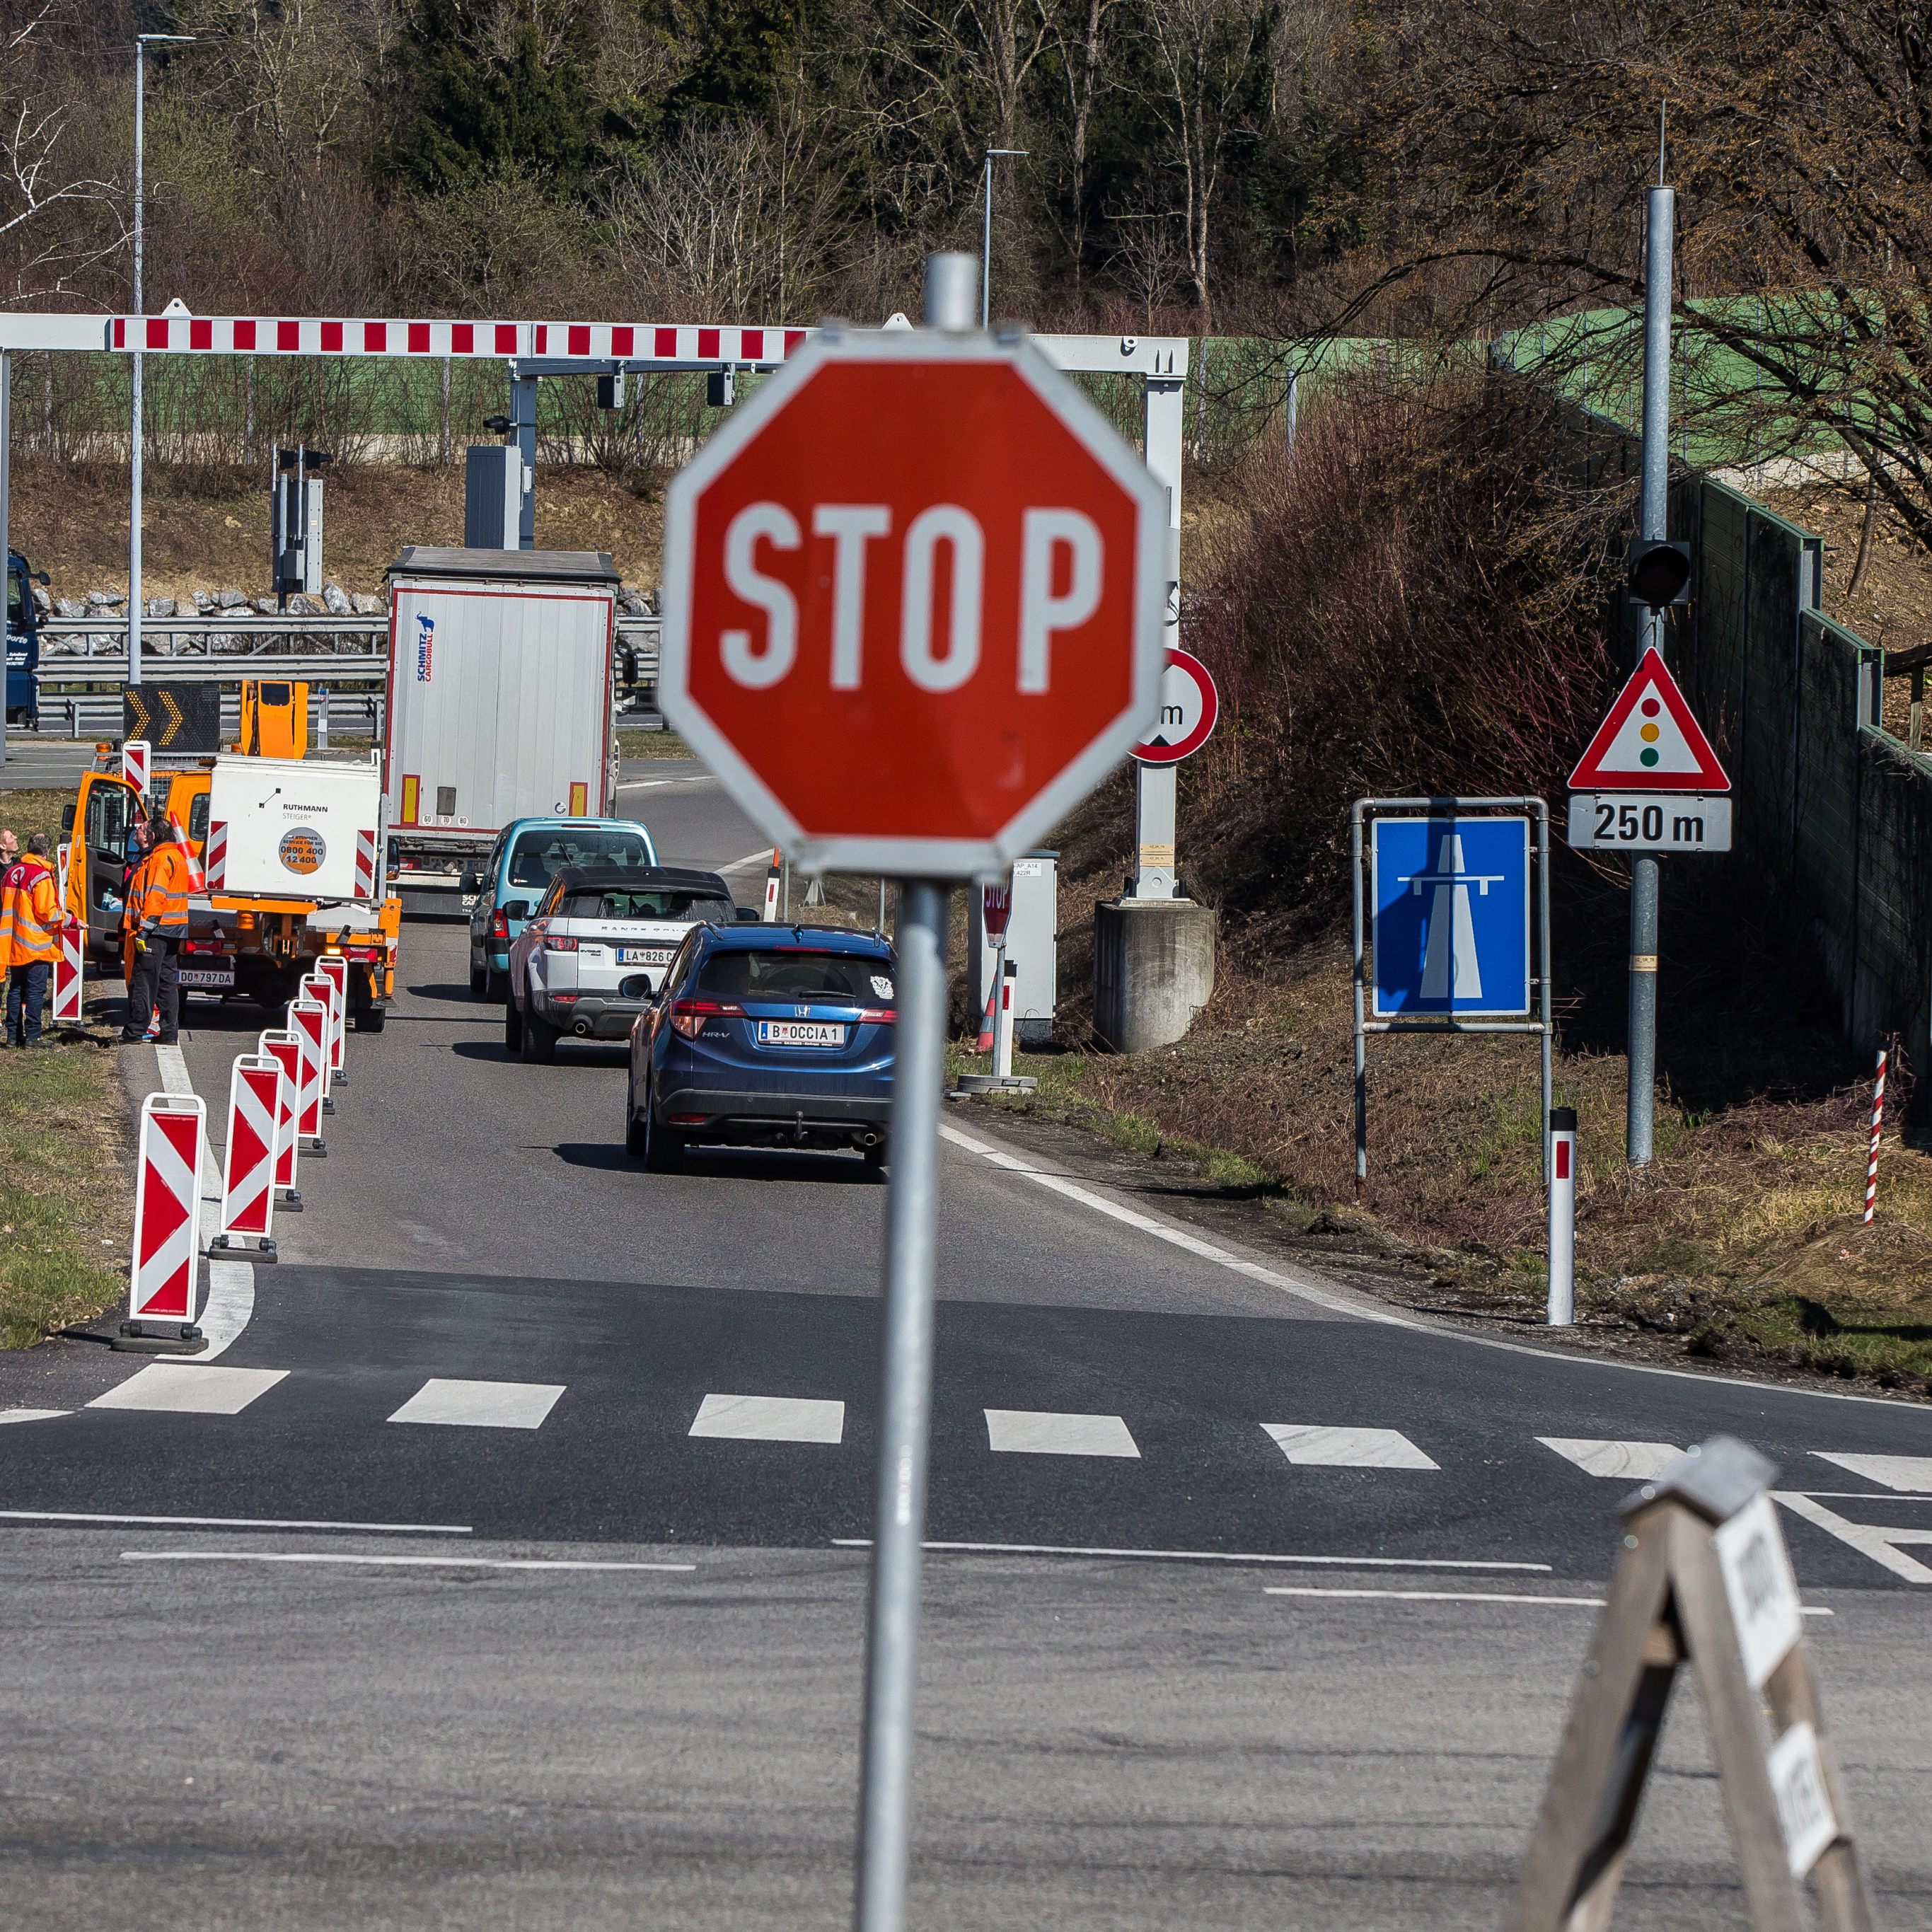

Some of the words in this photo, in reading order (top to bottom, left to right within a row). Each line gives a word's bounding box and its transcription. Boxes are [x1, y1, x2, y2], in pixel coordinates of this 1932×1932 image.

[719, 501, 1104, 695] STOP
[417, 632, 427, 682] SCHMITZ
[1160, 705, 1183, 725] m
[283, 804, 328, 813] RUTHMANN
[1593, 804, 1663, 841] 250
[1672, 816, 1703, 843] m
[626, 950, 639, 961] LA
[646, 951, 664, 961] 826
[181, 972, 193, 982] DO
[200, 973, 218, 983] 797
[219, 973, 231, 983] DA
[773, 1025, 780, 1038] B
[790, 1026, 828, 1040] OCCIA
[831, 1028, 837, 1041] 1
